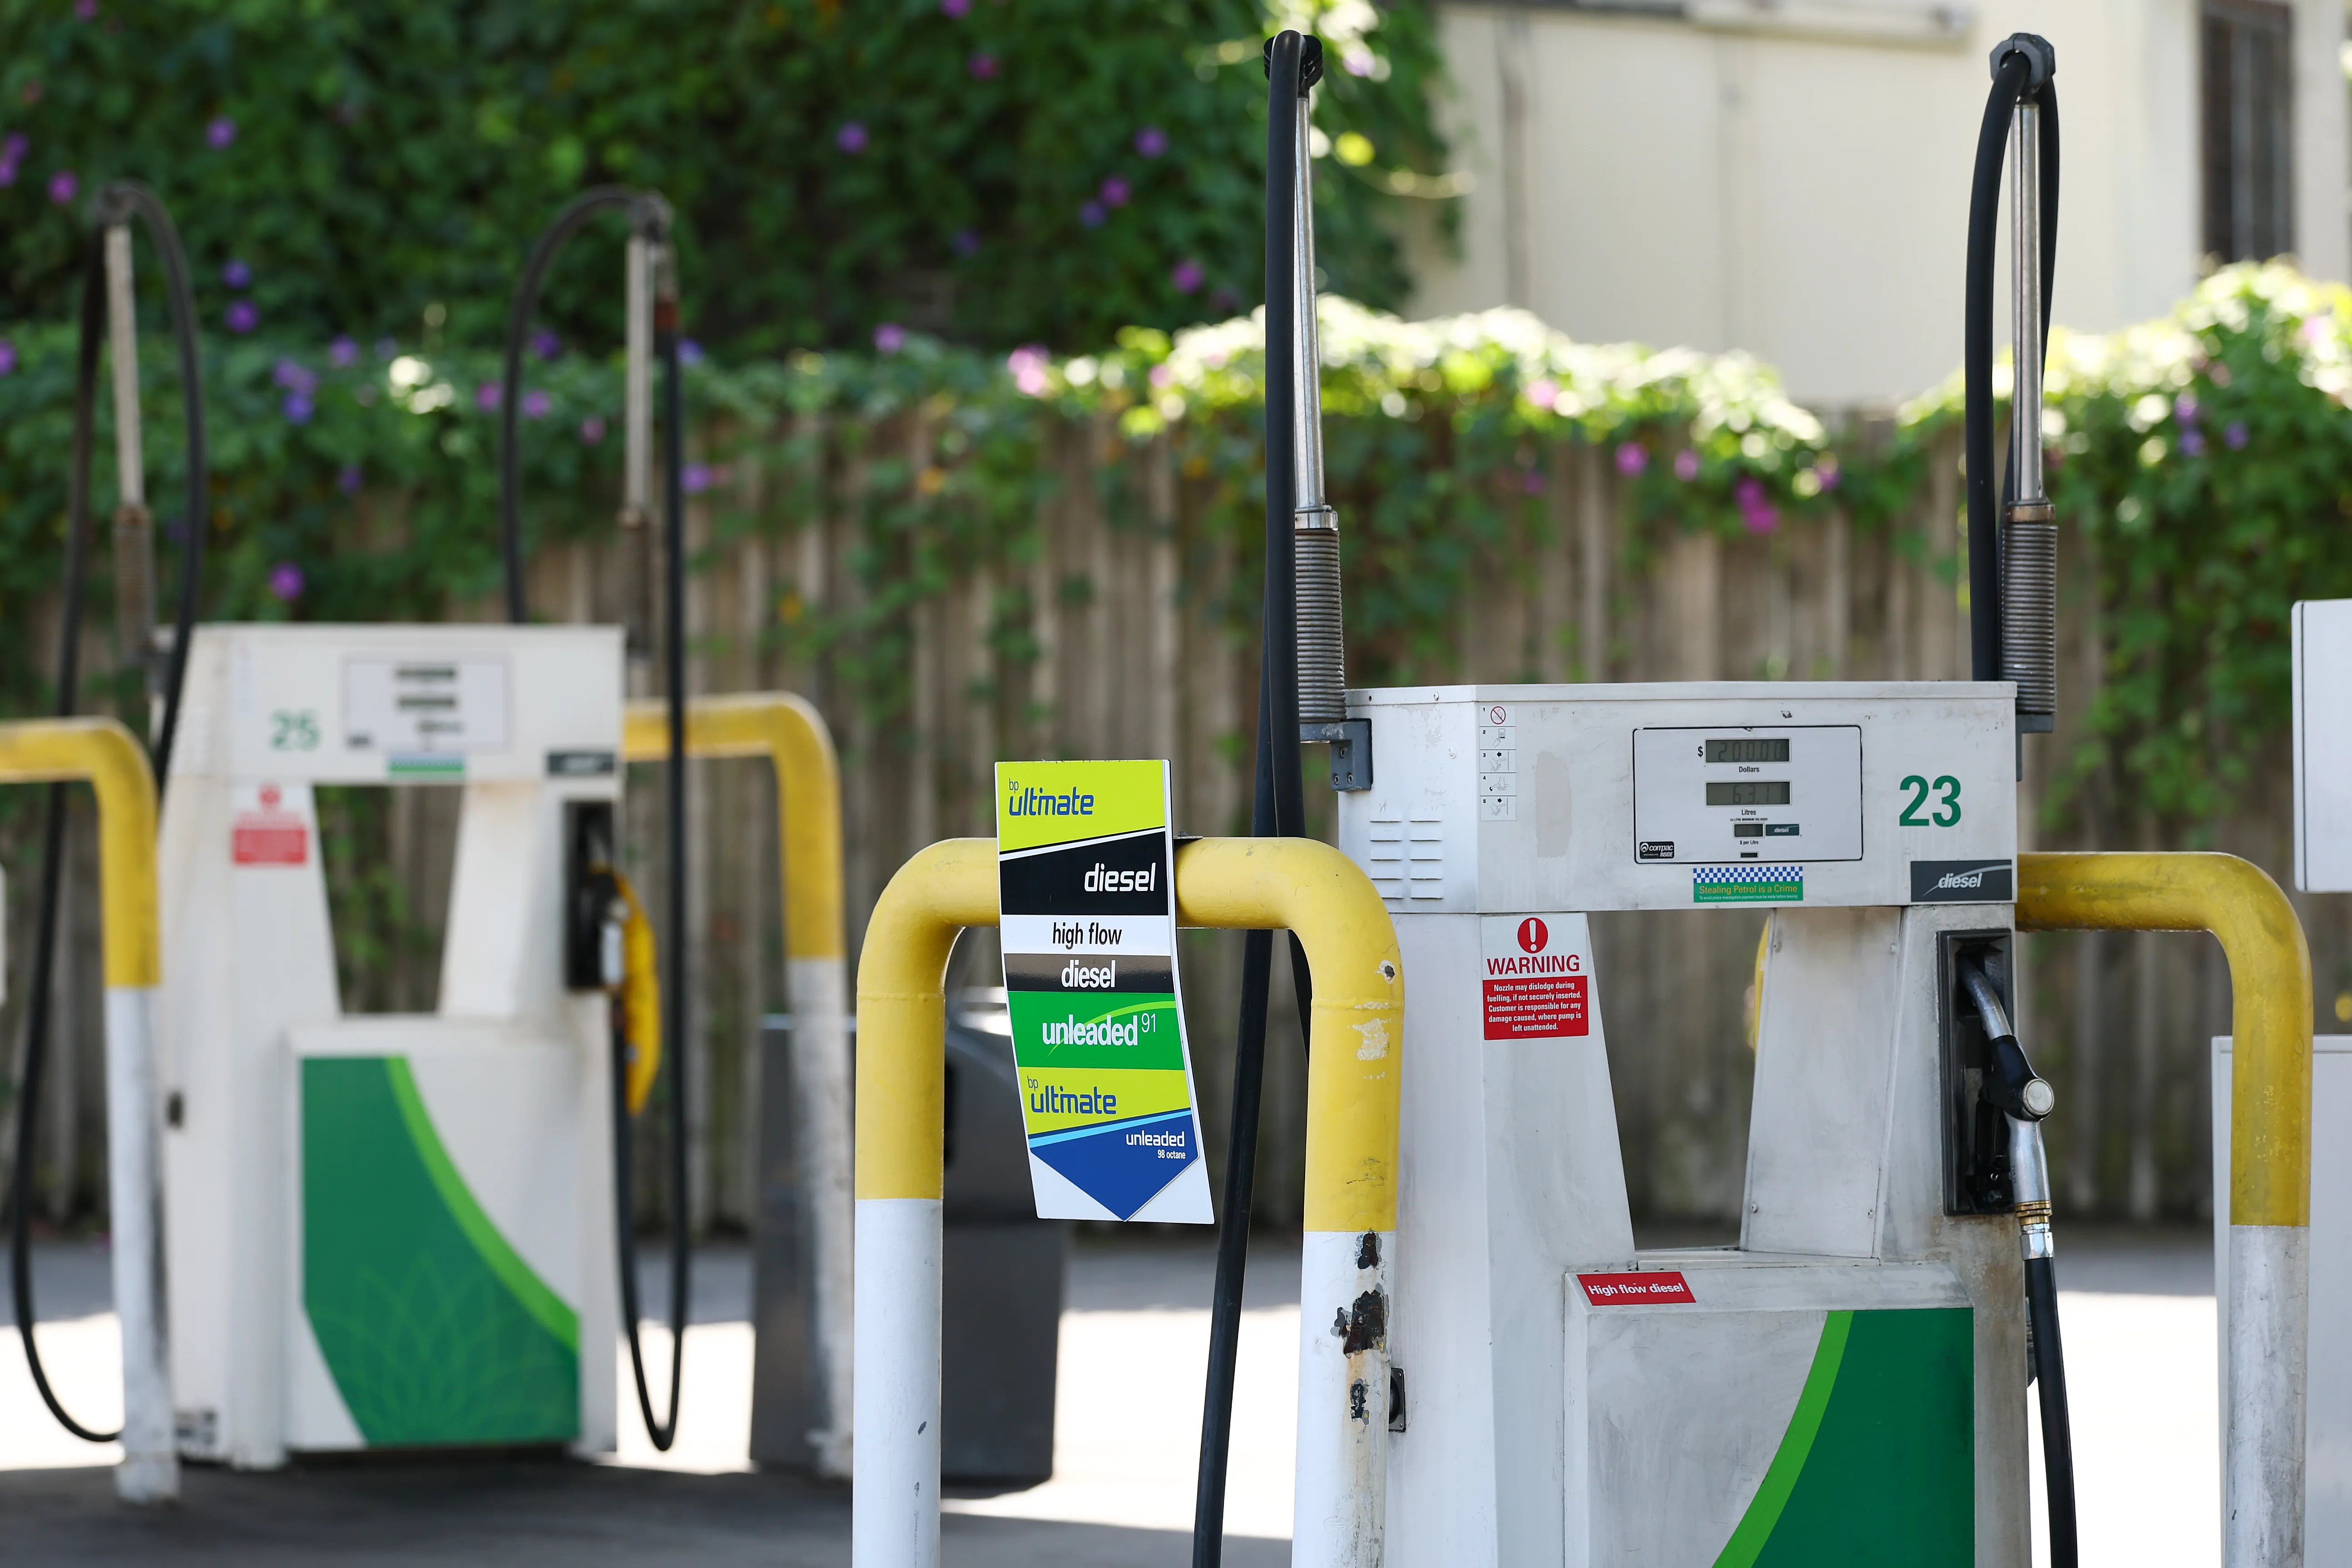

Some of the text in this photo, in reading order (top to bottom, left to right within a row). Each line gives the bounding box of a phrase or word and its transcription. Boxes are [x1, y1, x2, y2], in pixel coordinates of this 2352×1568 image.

[270, 708, 321, 752] 25
[1698, 746, 1703, 757] $
[1009, 778, 1019, 792] bp
[1009, 786, 1094, 816] ultimate
[1900, 775, 1961, 827] 23
[1084, 862, 1156, 892] diesel
[1938, 872, 1982, 888] diesel
[1699, 886, 1731, 895] Stealing
[1734, 885, 1756, 893] Petrol
[1053, 922, 1122, 950] high flow
[1487, 955, 1580, 975] WARNING
[1061, 960, 1116, 988] diesel
[1525, 1003, 1559, 1012] responsible
[1042, 1013, 1156, 1045] unleaded 91
[1524, 1023, 1558, 1031] unattended.
[1027, 1076, 1038, 1091] bp
[1031, 1086, 1116, 1114] ultimate
[1126, 1130, 1184, 1147] unleaded
[1158, 1150, 1185, 1159] 98 octane
[1588, 1283, 1684, 1296] High flow diesel
